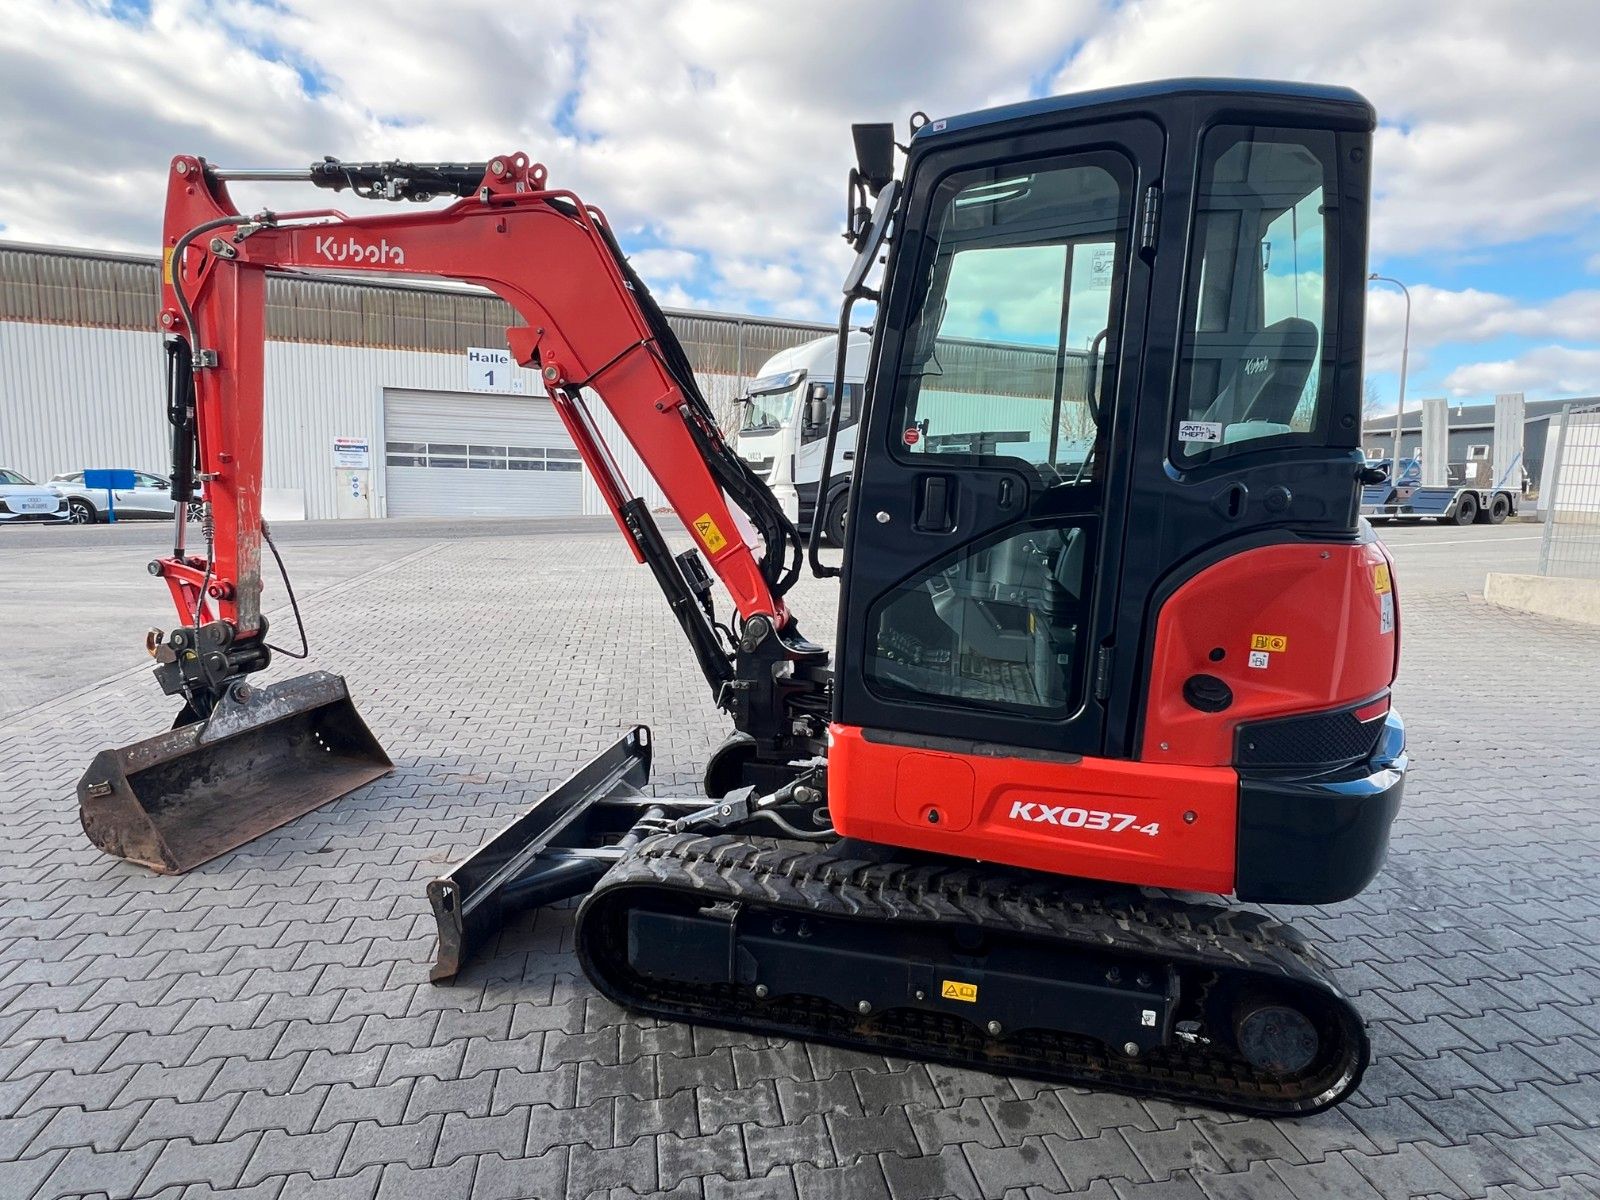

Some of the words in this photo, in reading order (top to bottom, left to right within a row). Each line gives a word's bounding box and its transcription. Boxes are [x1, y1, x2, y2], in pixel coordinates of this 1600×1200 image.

[315, 235, 405, 265] Kubota
[469, 351, 508, 364] Halle
[484, 370, 494, 386] 1
[1008, 800, 1160, 836] KX037-4
